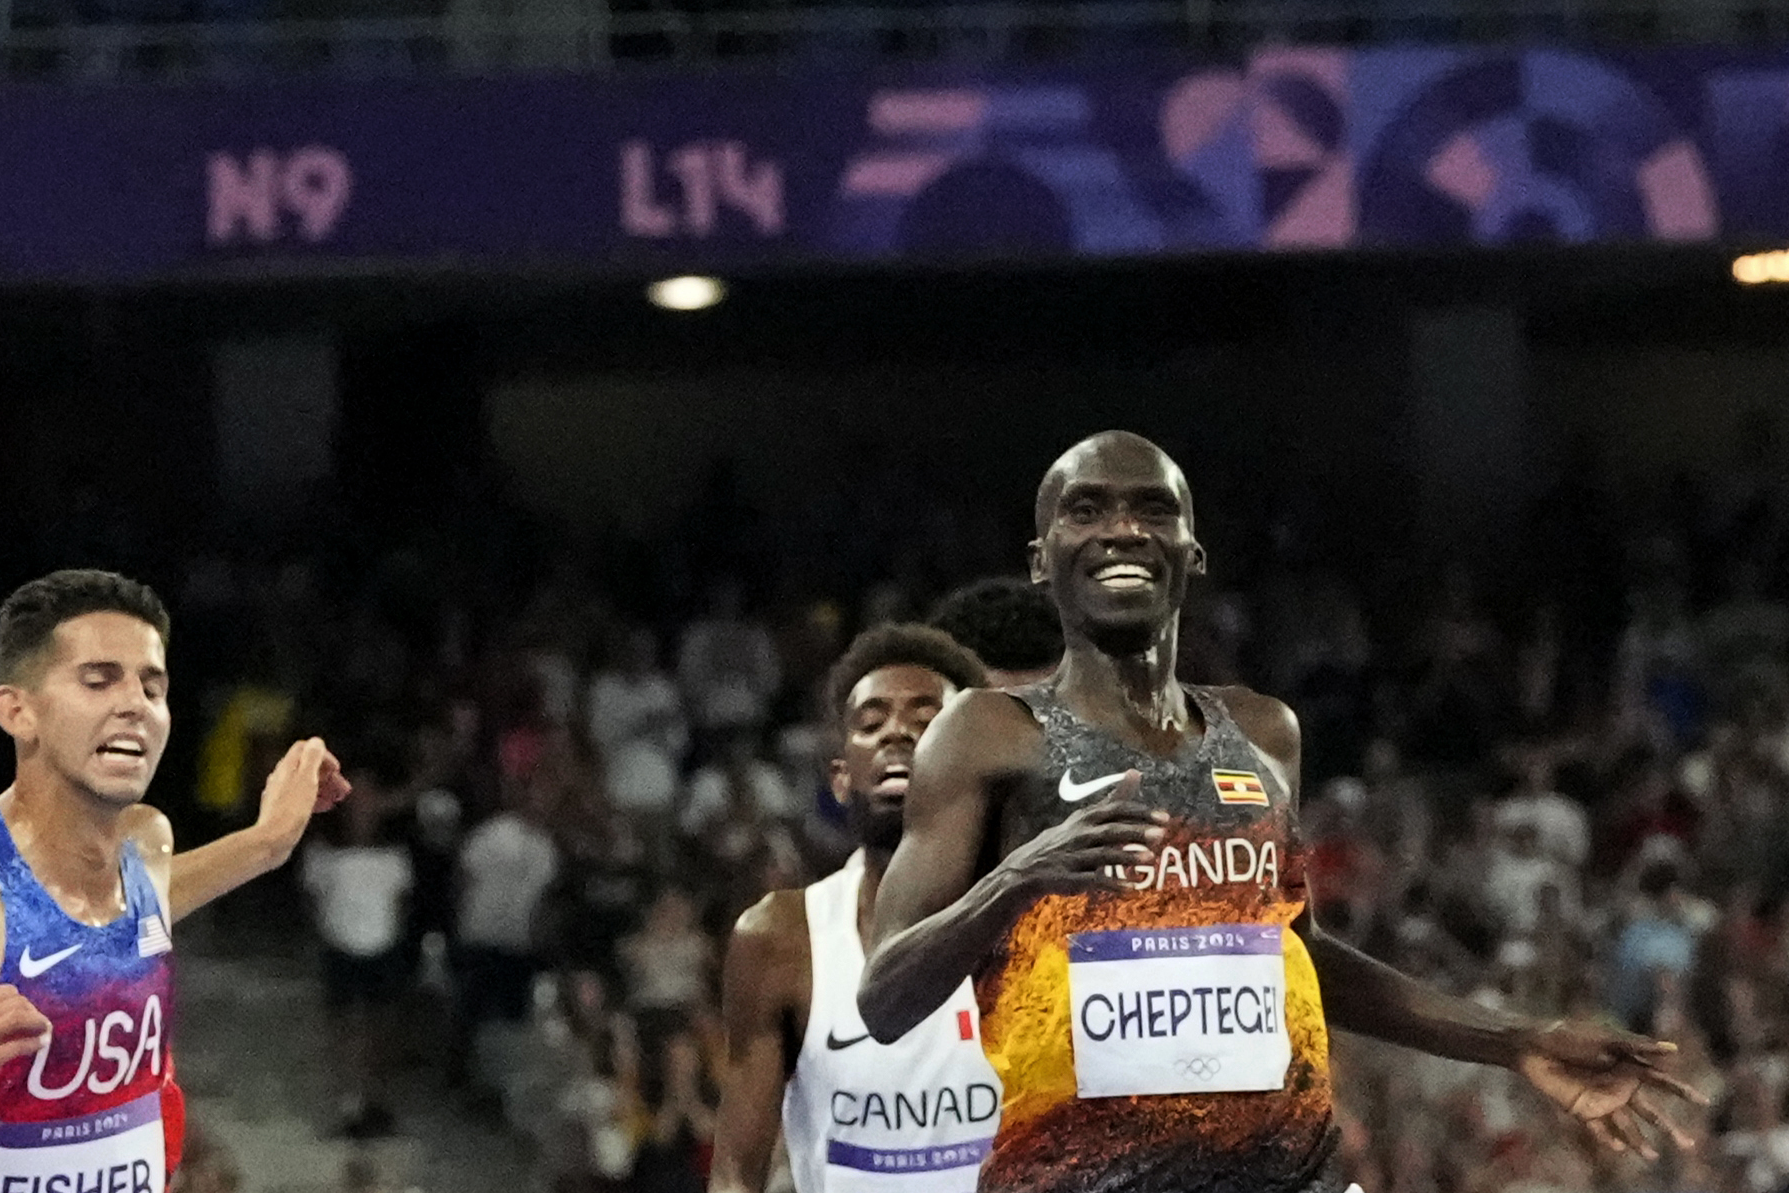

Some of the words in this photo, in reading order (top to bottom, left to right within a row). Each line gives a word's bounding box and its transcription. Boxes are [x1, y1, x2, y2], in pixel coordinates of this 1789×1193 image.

[1103, 836, 1278, 891] GANDA
[1131, 935, 1191, 952] PARIS
[1194, 932, 1246, 948] 2024
[1081, 985, 1279, 1043] CHEPTEGEI
[27, 994, 162, 1101] USA
[40, 1122, 91, 1142] PARIS
